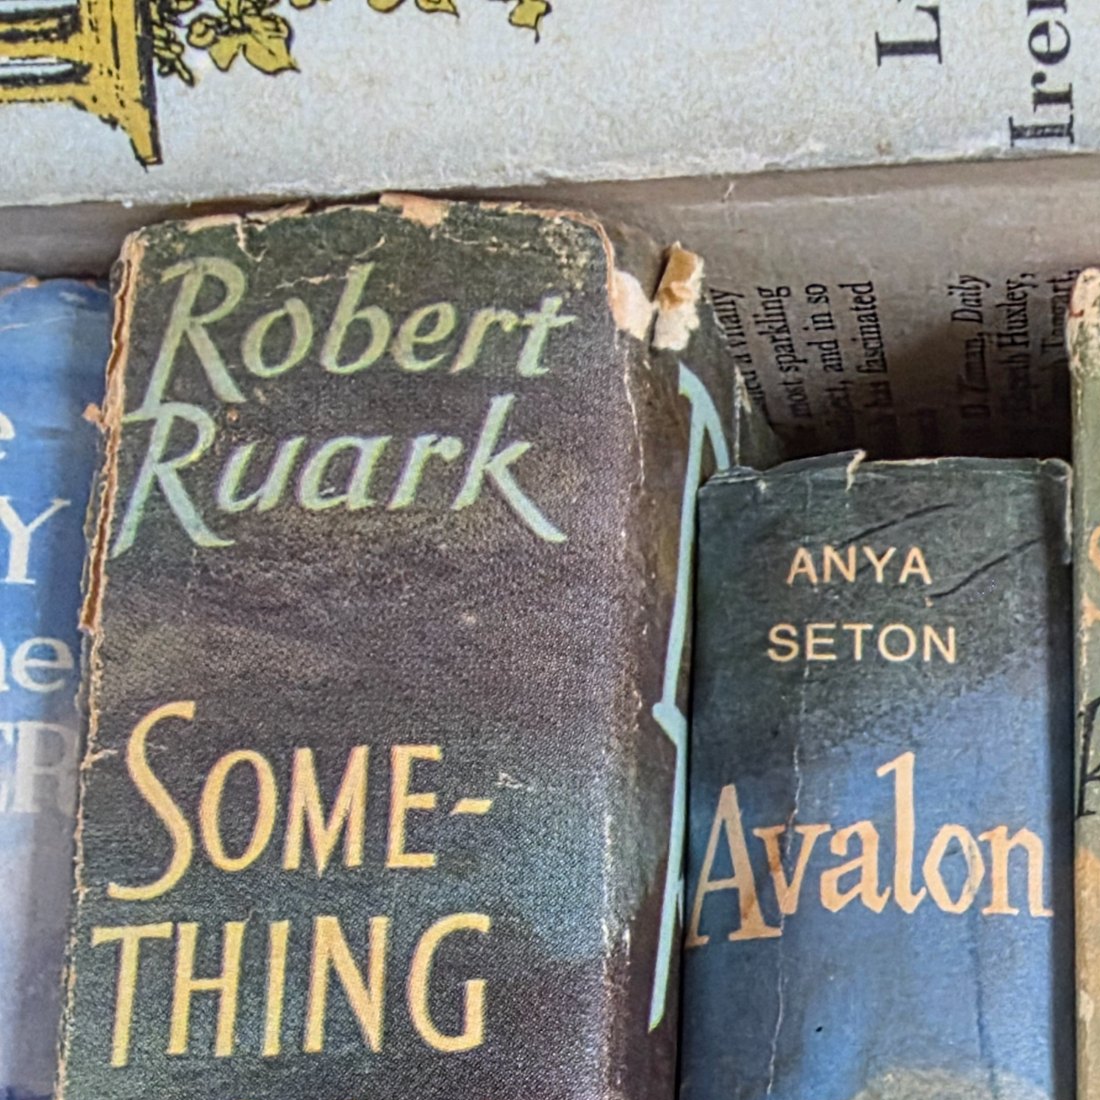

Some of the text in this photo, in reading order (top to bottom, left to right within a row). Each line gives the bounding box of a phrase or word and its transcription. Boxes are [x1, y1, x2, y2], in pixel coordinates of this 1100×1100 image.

[1008, 0, 1074, 147] Ire
[131, 257, 577, 410] Robert
[751, 285, 808, 373] sparkling
[802, 312, 836, 331] in
[805, 283, 830, 304] so
[838, 280, 888, 374] fascinated
[947, 274, 991, 323] Daily
[995, 273, 1038, 348] Huxley,
[806, 338, 844, 373] and
[108, 393, 567, 560] Ruark
[786, 546, 933, 585] ANYA
[766, 622, 957, 664] SETON
[106, 699, 493, 901] SOME-
[684, 752, 1054, 949] Avalon
[91, 911, 492, 1068] THING
